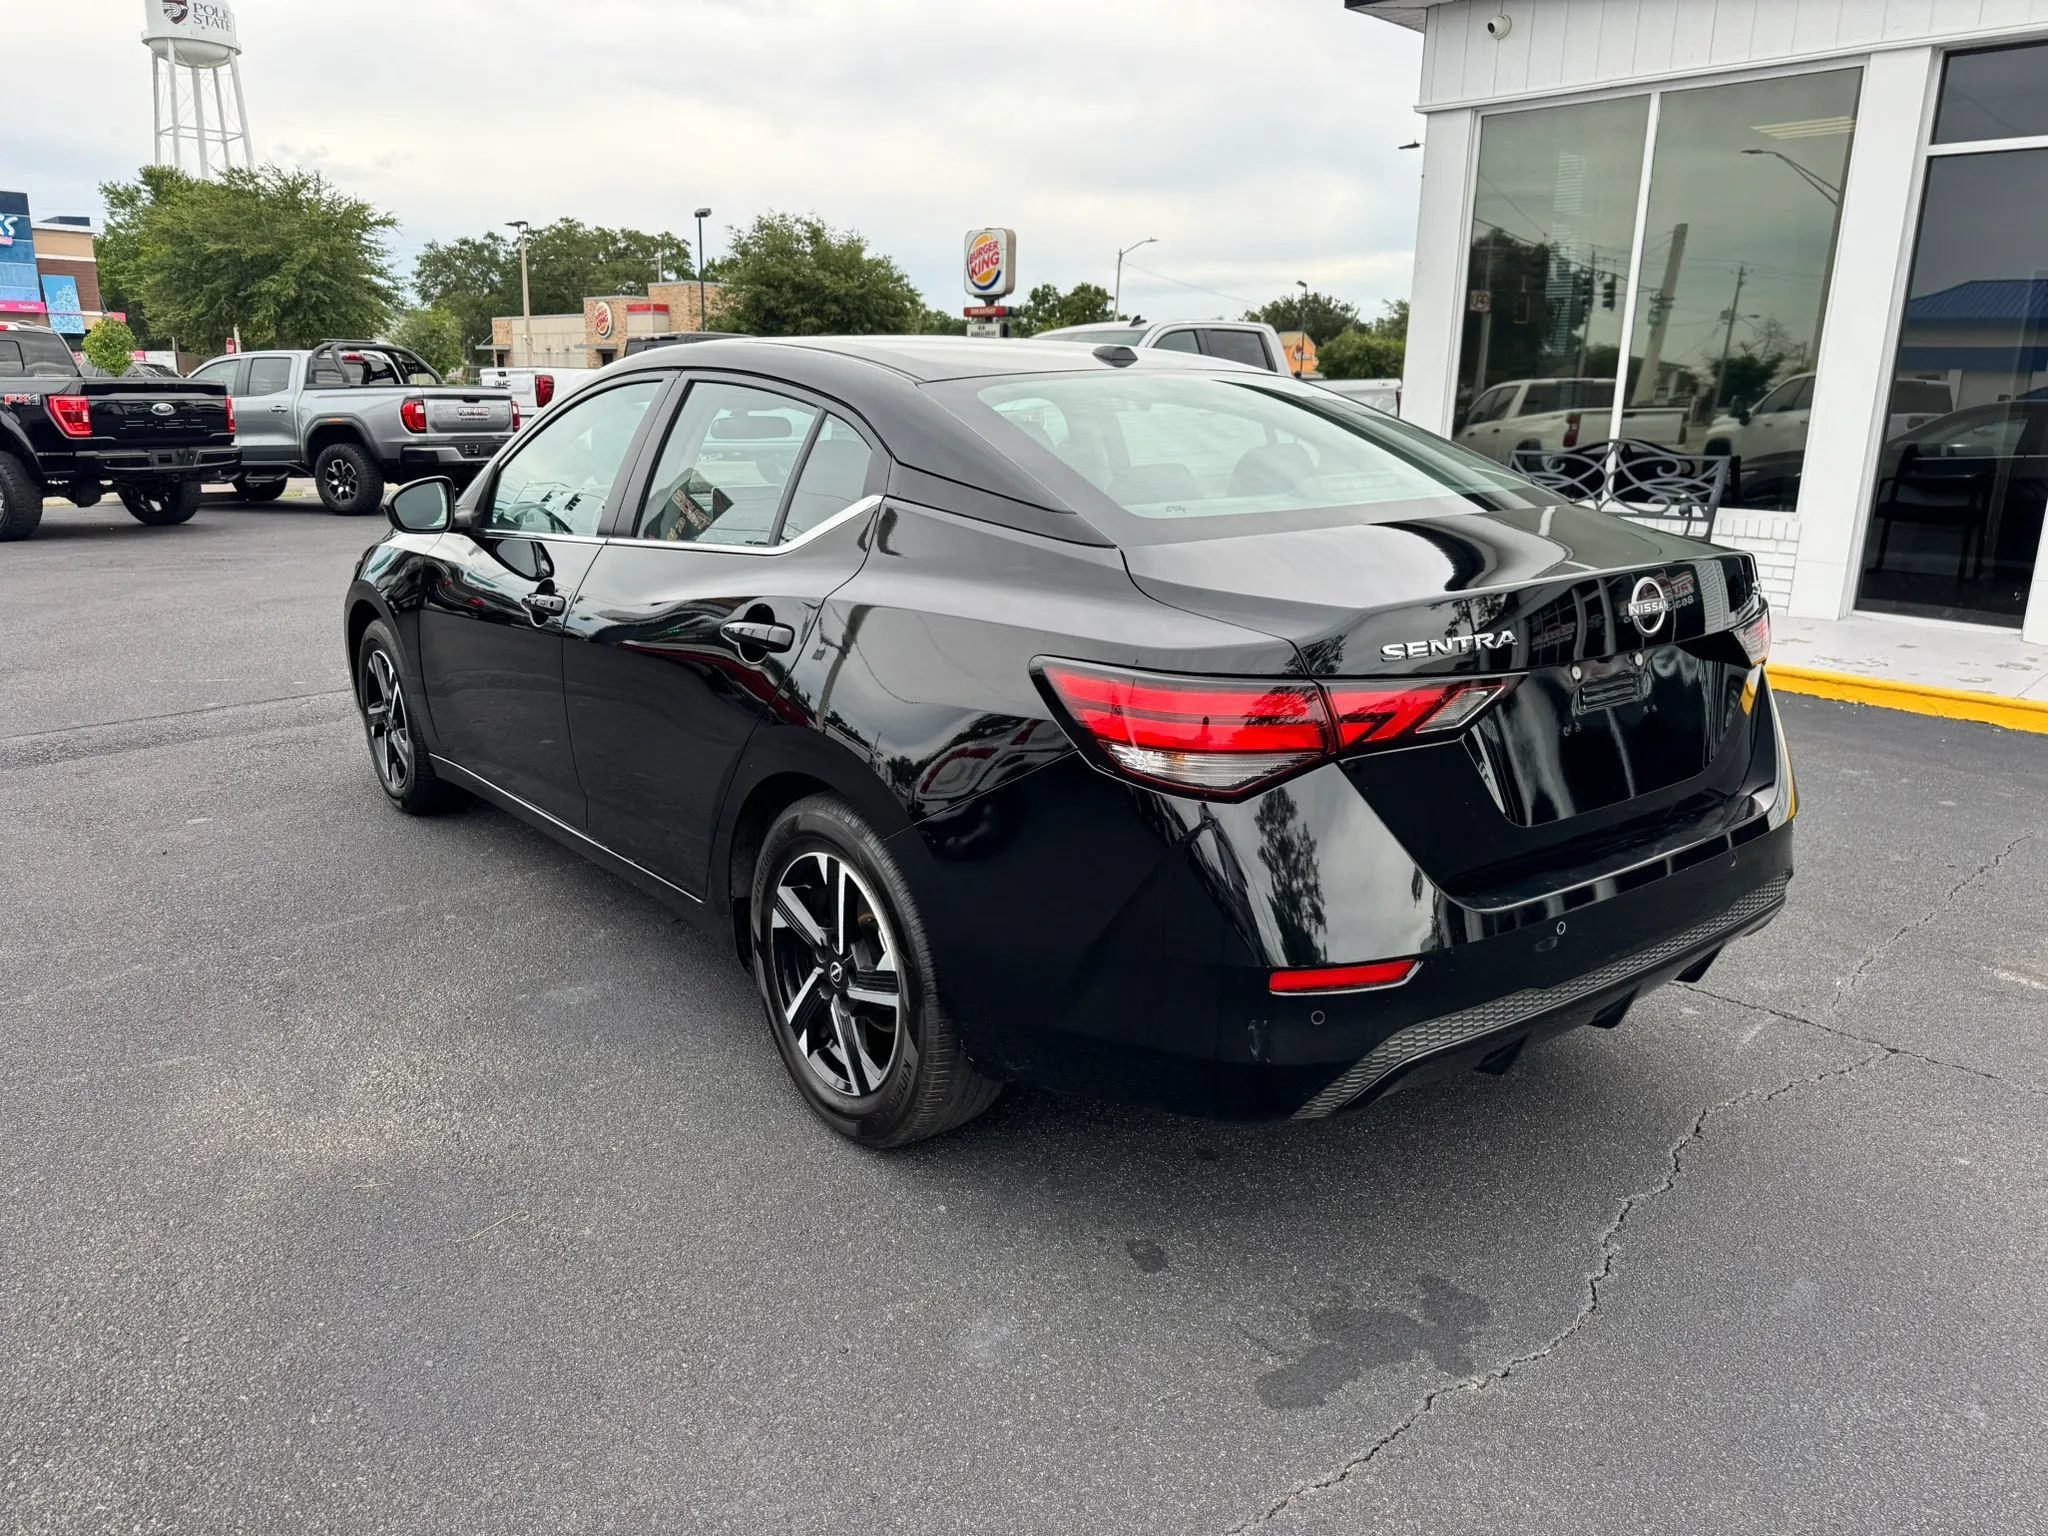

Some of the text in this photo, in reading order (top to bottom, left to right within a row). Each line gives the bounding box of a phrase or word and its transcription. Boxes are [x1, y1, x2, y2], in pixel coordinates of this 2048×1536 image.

[193, 3, 230, 20] POLK
[193, 14, 232, 32] STATE
[969, 241, 999, 265] BURGER
[970, 251, 1001, 279] KING
[4, 393, 41, 405] FX4
[1629, 600, 1669, 616] NISSAN
[1380, 630, 1518, 662] SENTRA
